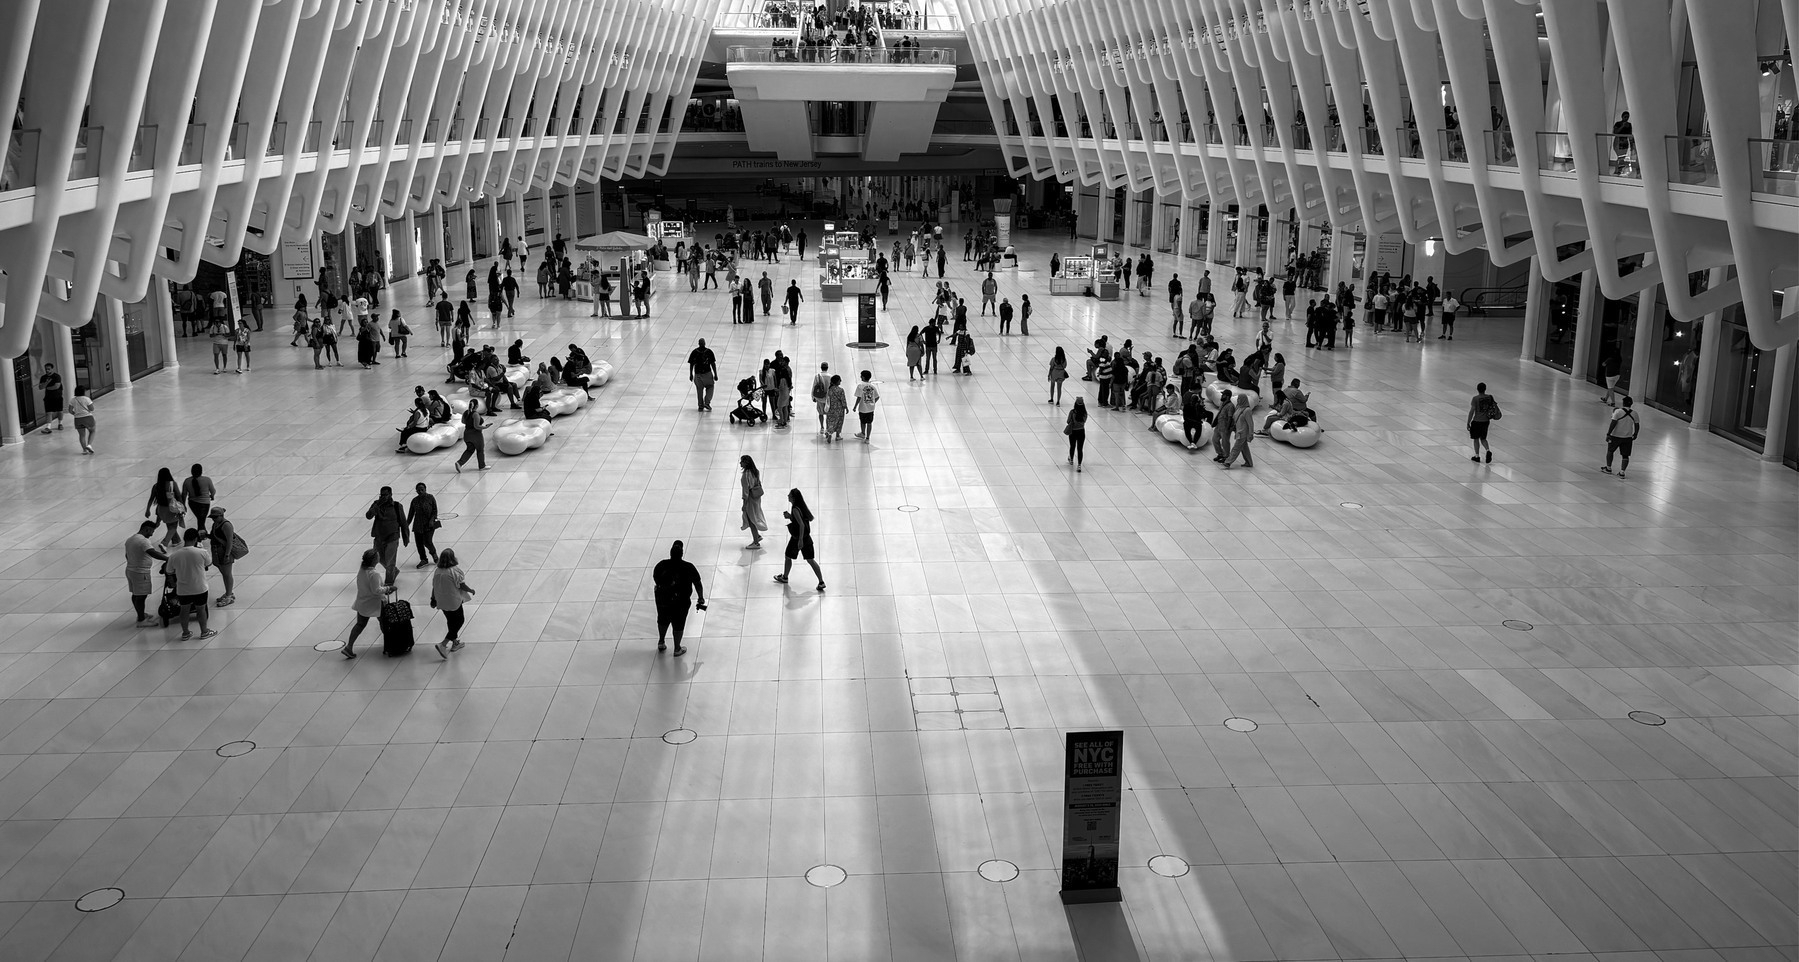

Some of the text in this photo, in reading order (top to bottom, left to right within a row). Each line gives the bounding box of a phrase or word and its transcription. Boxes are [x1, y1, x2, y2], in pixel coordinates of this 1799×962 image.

[753, 160, 774, 168] trains
[799, 160, 822, 169] Jersey
[1074, 747, 1114, 763] NYC
